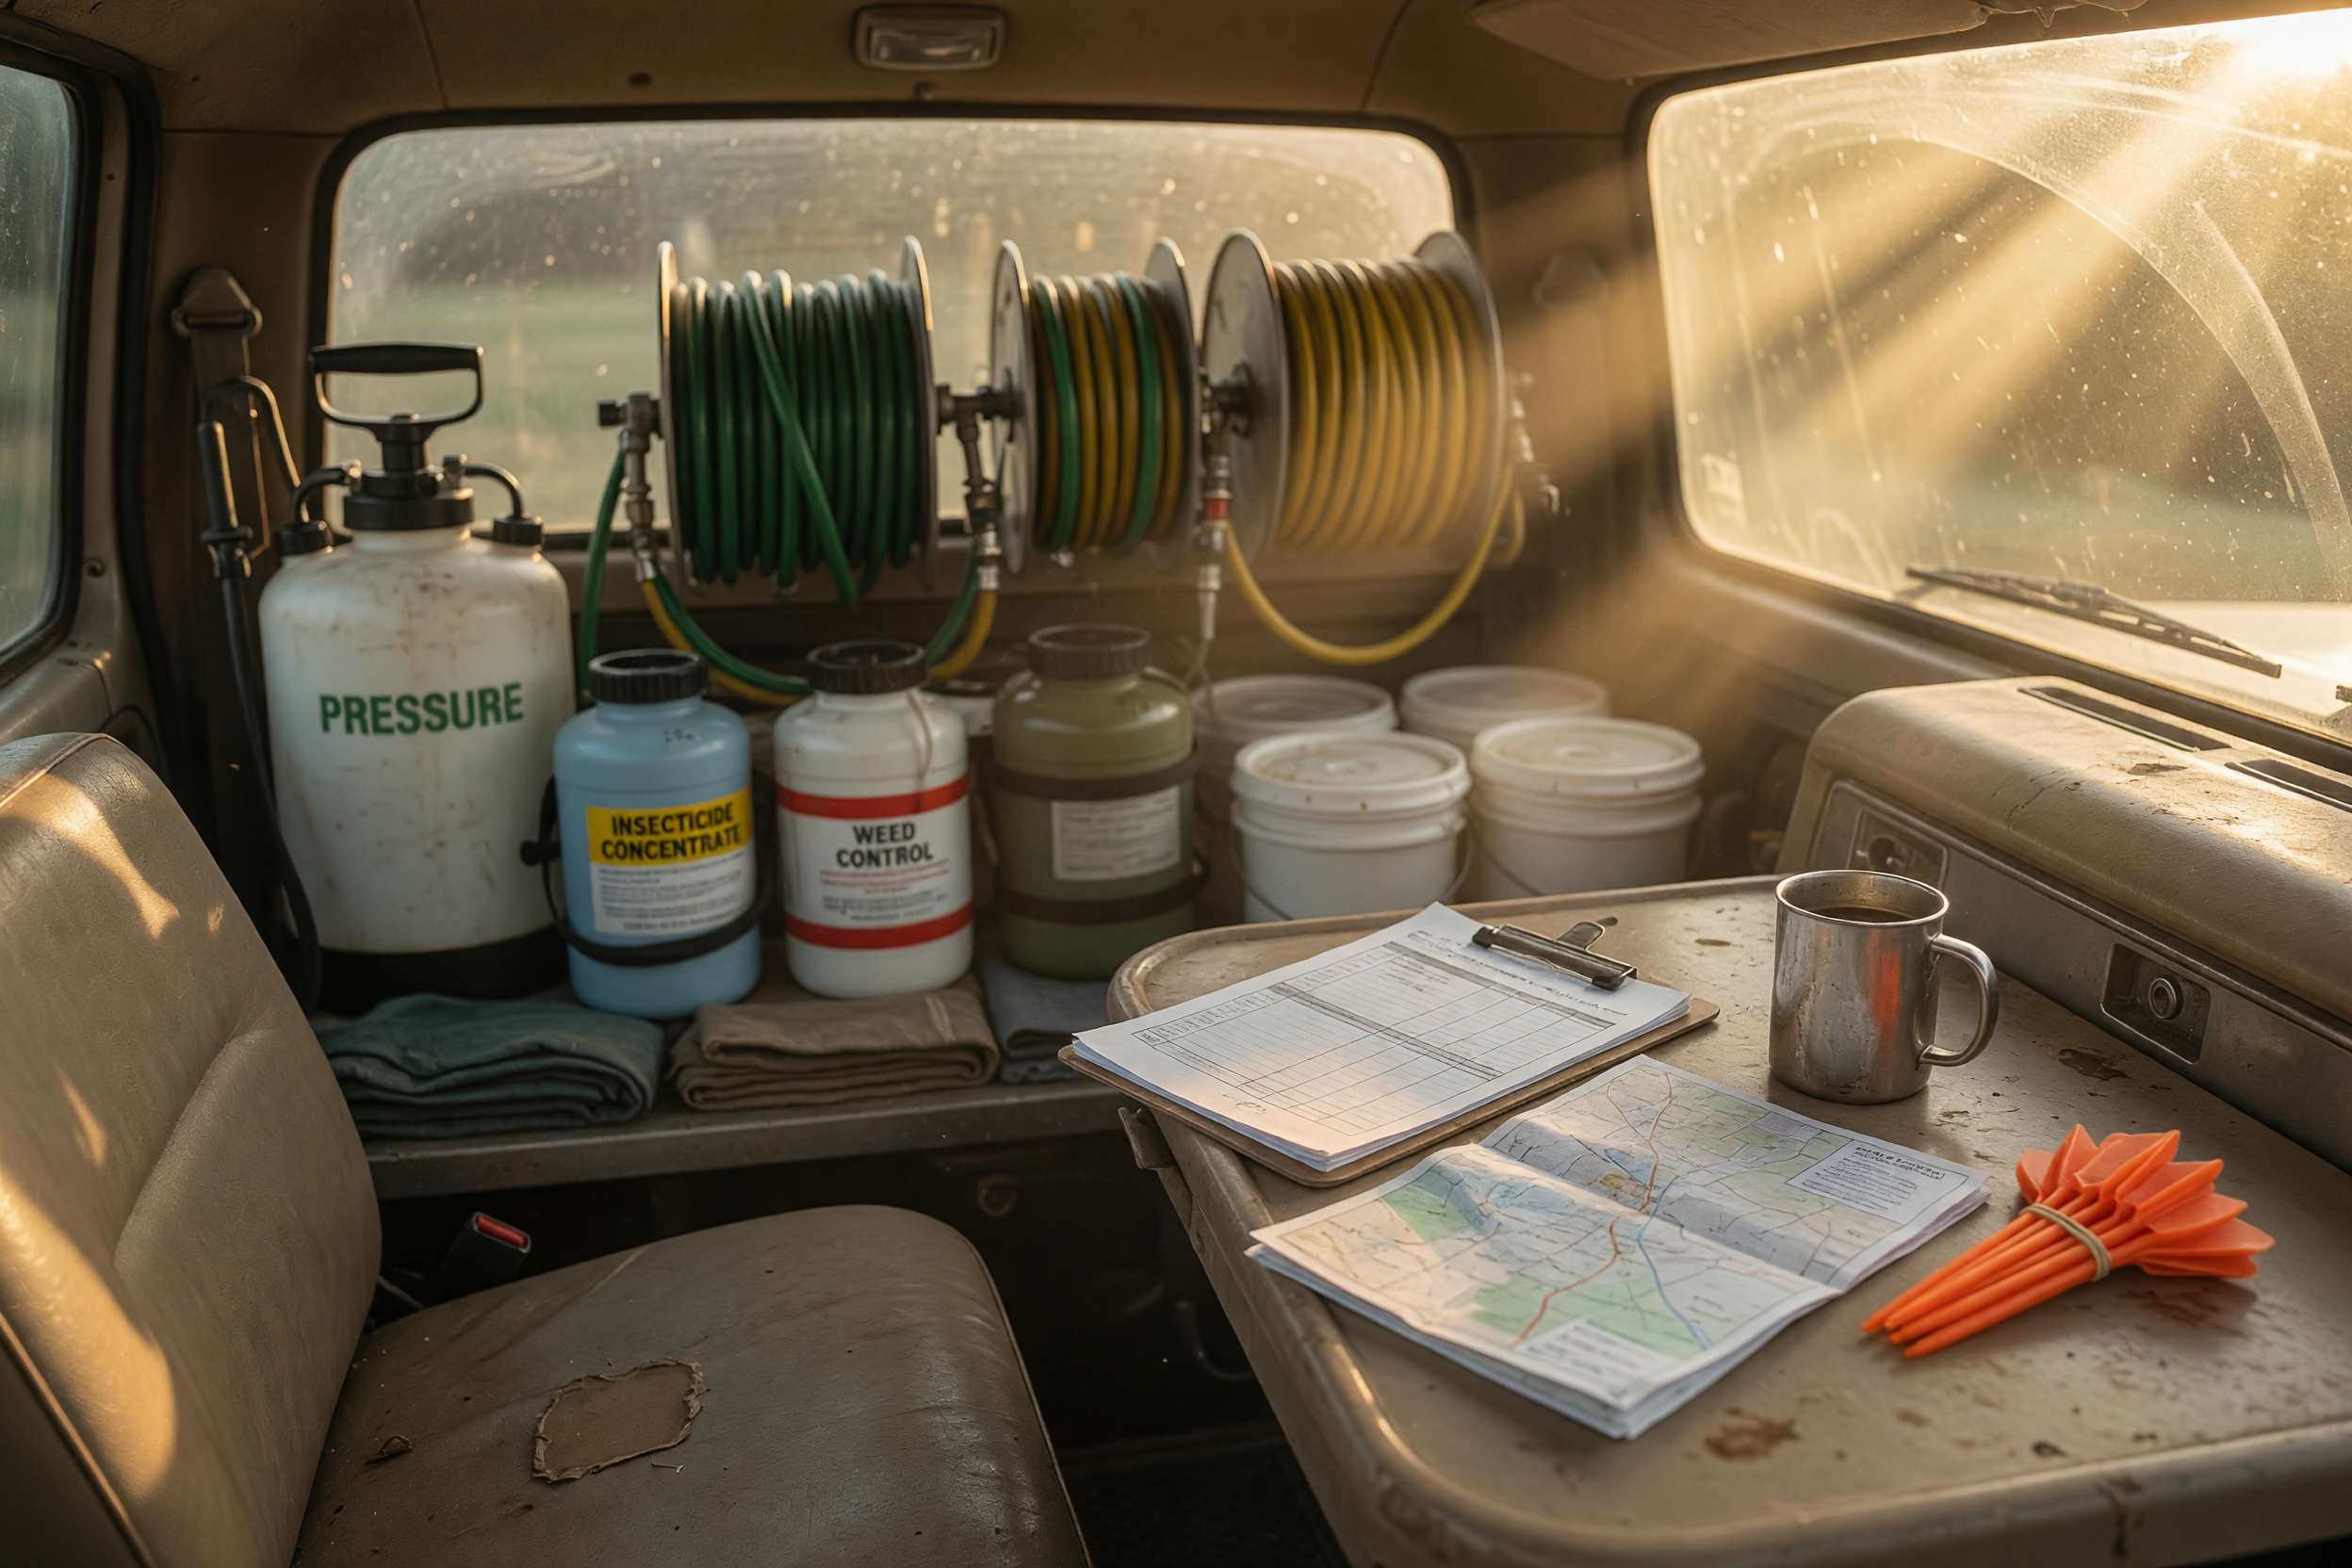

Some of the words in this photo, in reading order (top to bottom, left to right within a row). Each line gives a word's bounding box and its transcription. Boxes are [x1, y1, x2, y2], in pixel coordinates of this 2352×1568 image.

[319, 682, 523, 735] PRESSURE
[612, 803, 733, 836] INSECTICIDE
[853, 822, 915, 844] WEED
[601, 825, 741, 860] CONCENTRATE
[837, 842, 933, 867] CONTROL
